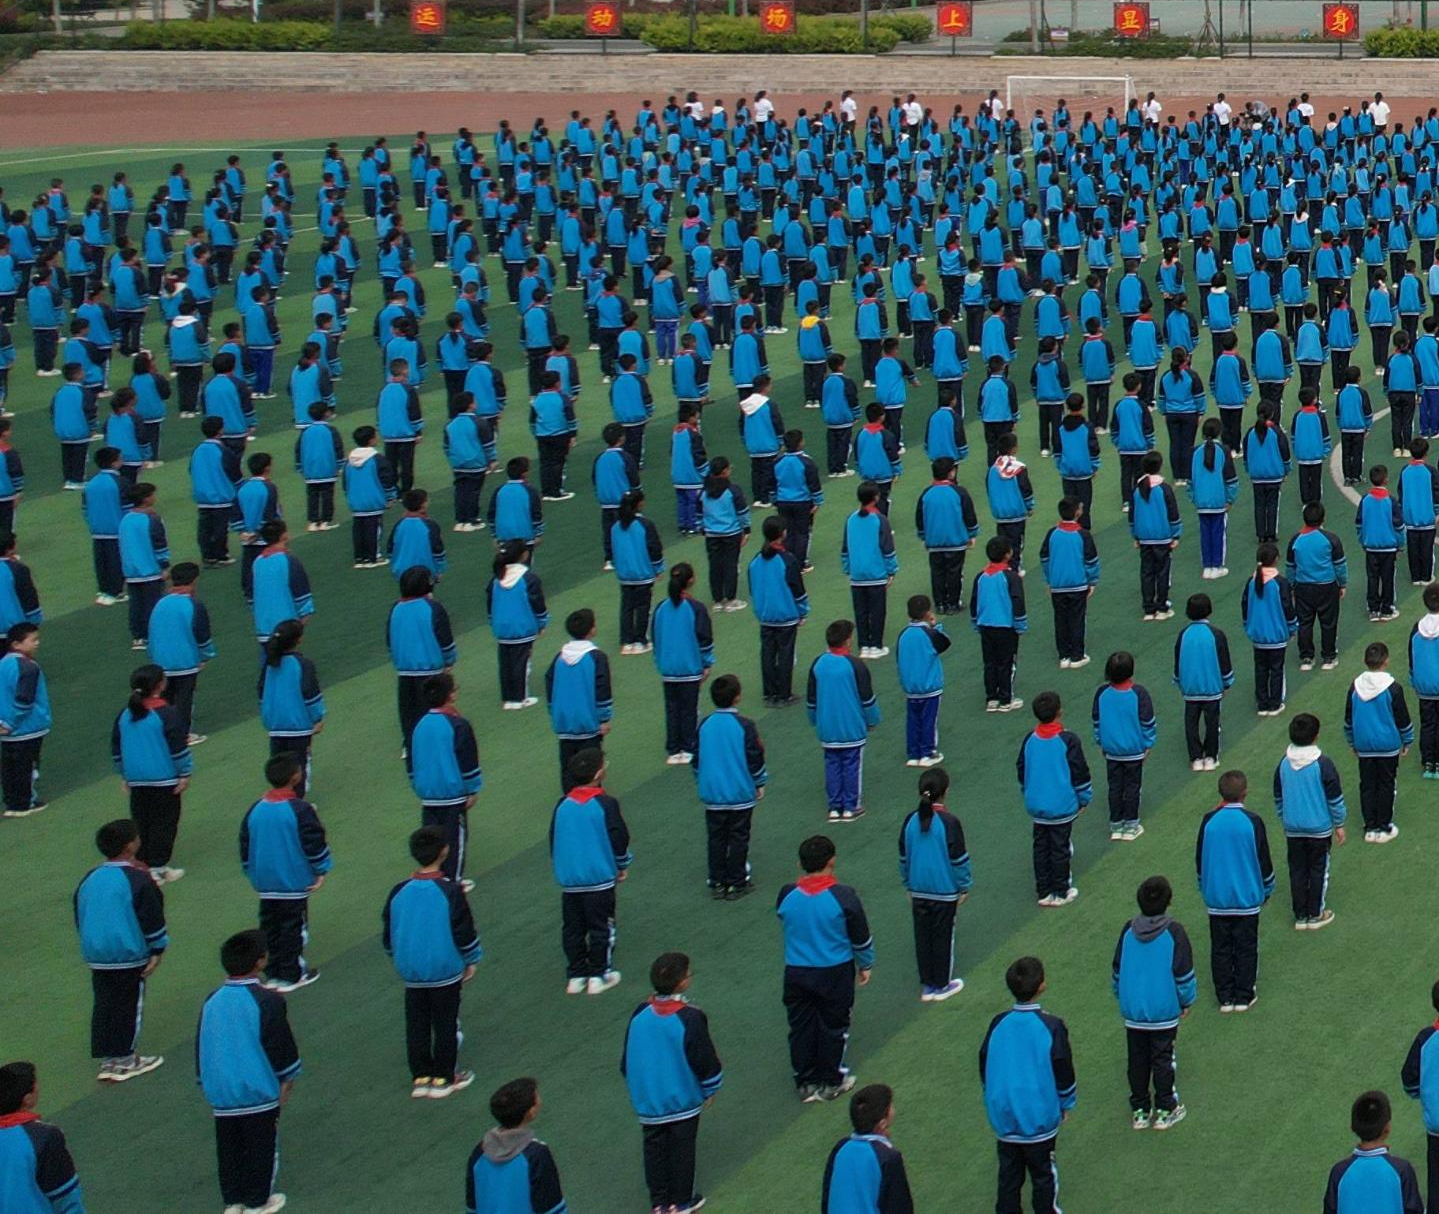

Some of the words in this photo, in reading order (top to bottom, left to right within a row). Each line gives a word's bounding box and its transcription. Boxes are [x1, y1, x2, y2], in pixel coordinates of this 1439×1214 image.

[416, 8, 439, 26] 运
[592, 10, 613, 27] 动
[767, 8, 787, 27] 场
[943, 10, 963, 28] 上
[1121, 10, 1141, 29] 显
[1331, 9, 1349, 32] 身
